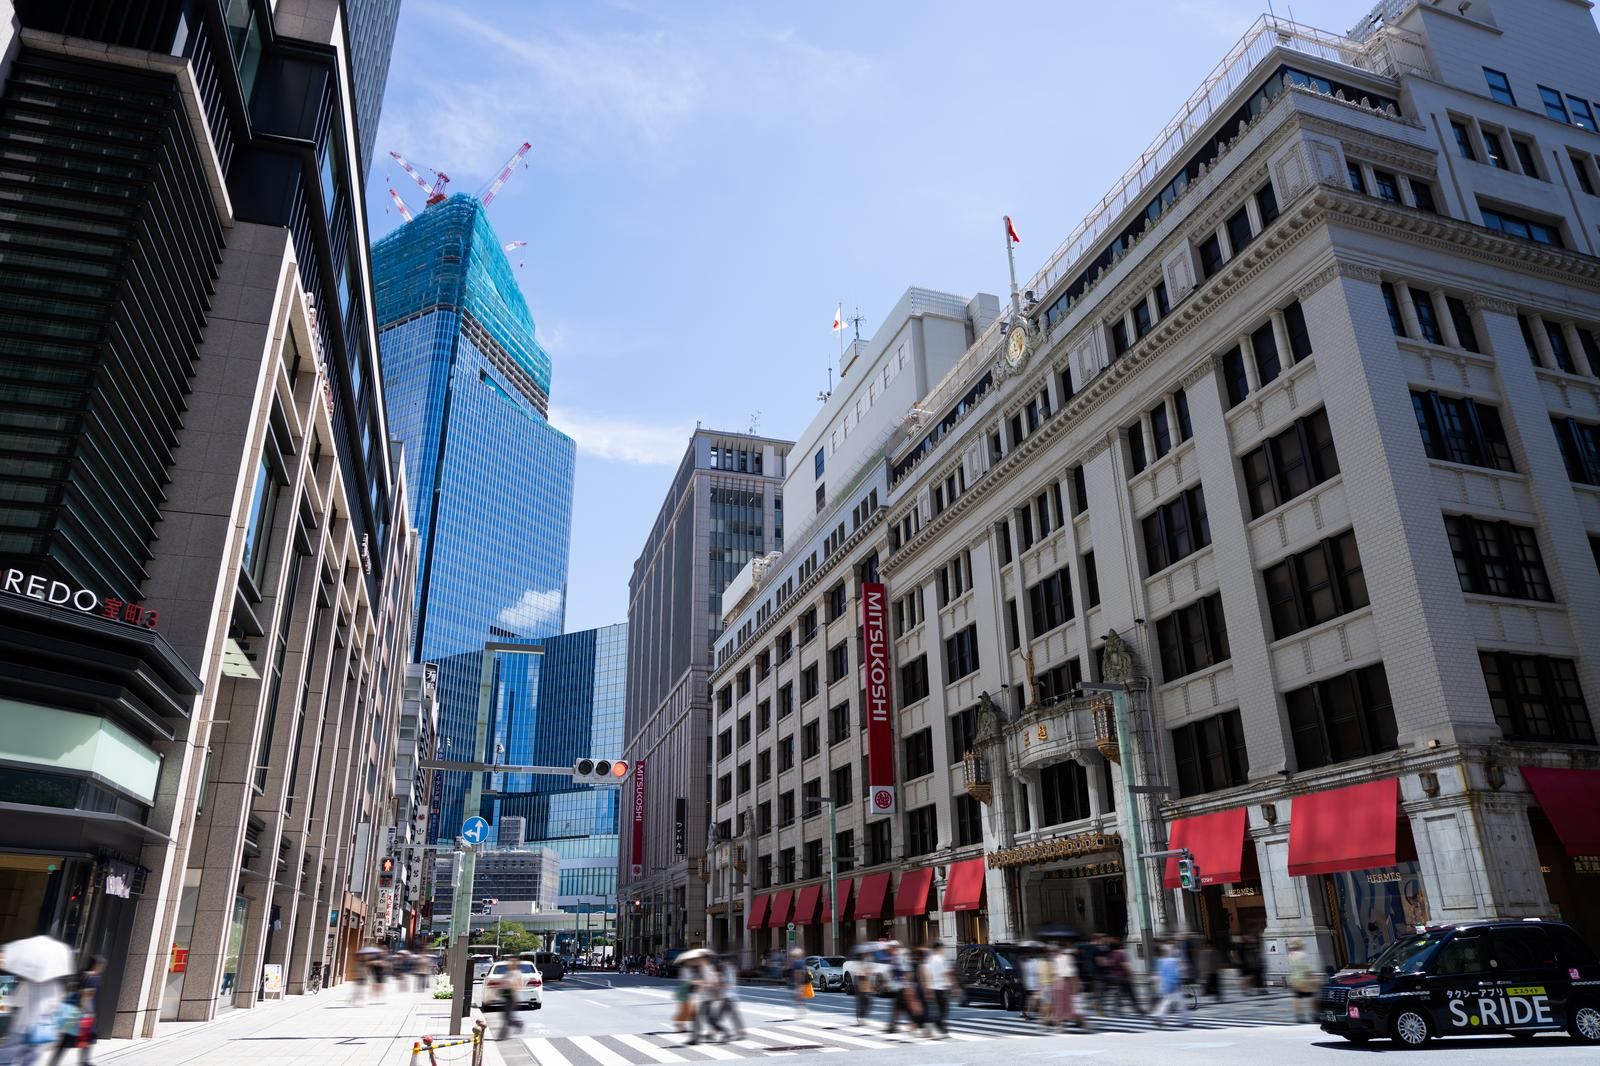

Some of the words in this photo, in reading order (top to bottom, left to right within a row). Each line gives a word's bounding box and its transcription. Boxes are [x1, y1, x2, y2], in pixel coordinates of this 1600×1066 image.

[0, 568, 98, 611] REDO
[102, 597, 160, 629] 室町3
[867, 592, 887, 721] MITSUKOSHI
[635, 764, 645, 822] MITSUKOSHI
[1446, 988, 1504, 999] タクシーアプリ
[1449, 996, 1553, 1027] S.RIDE
